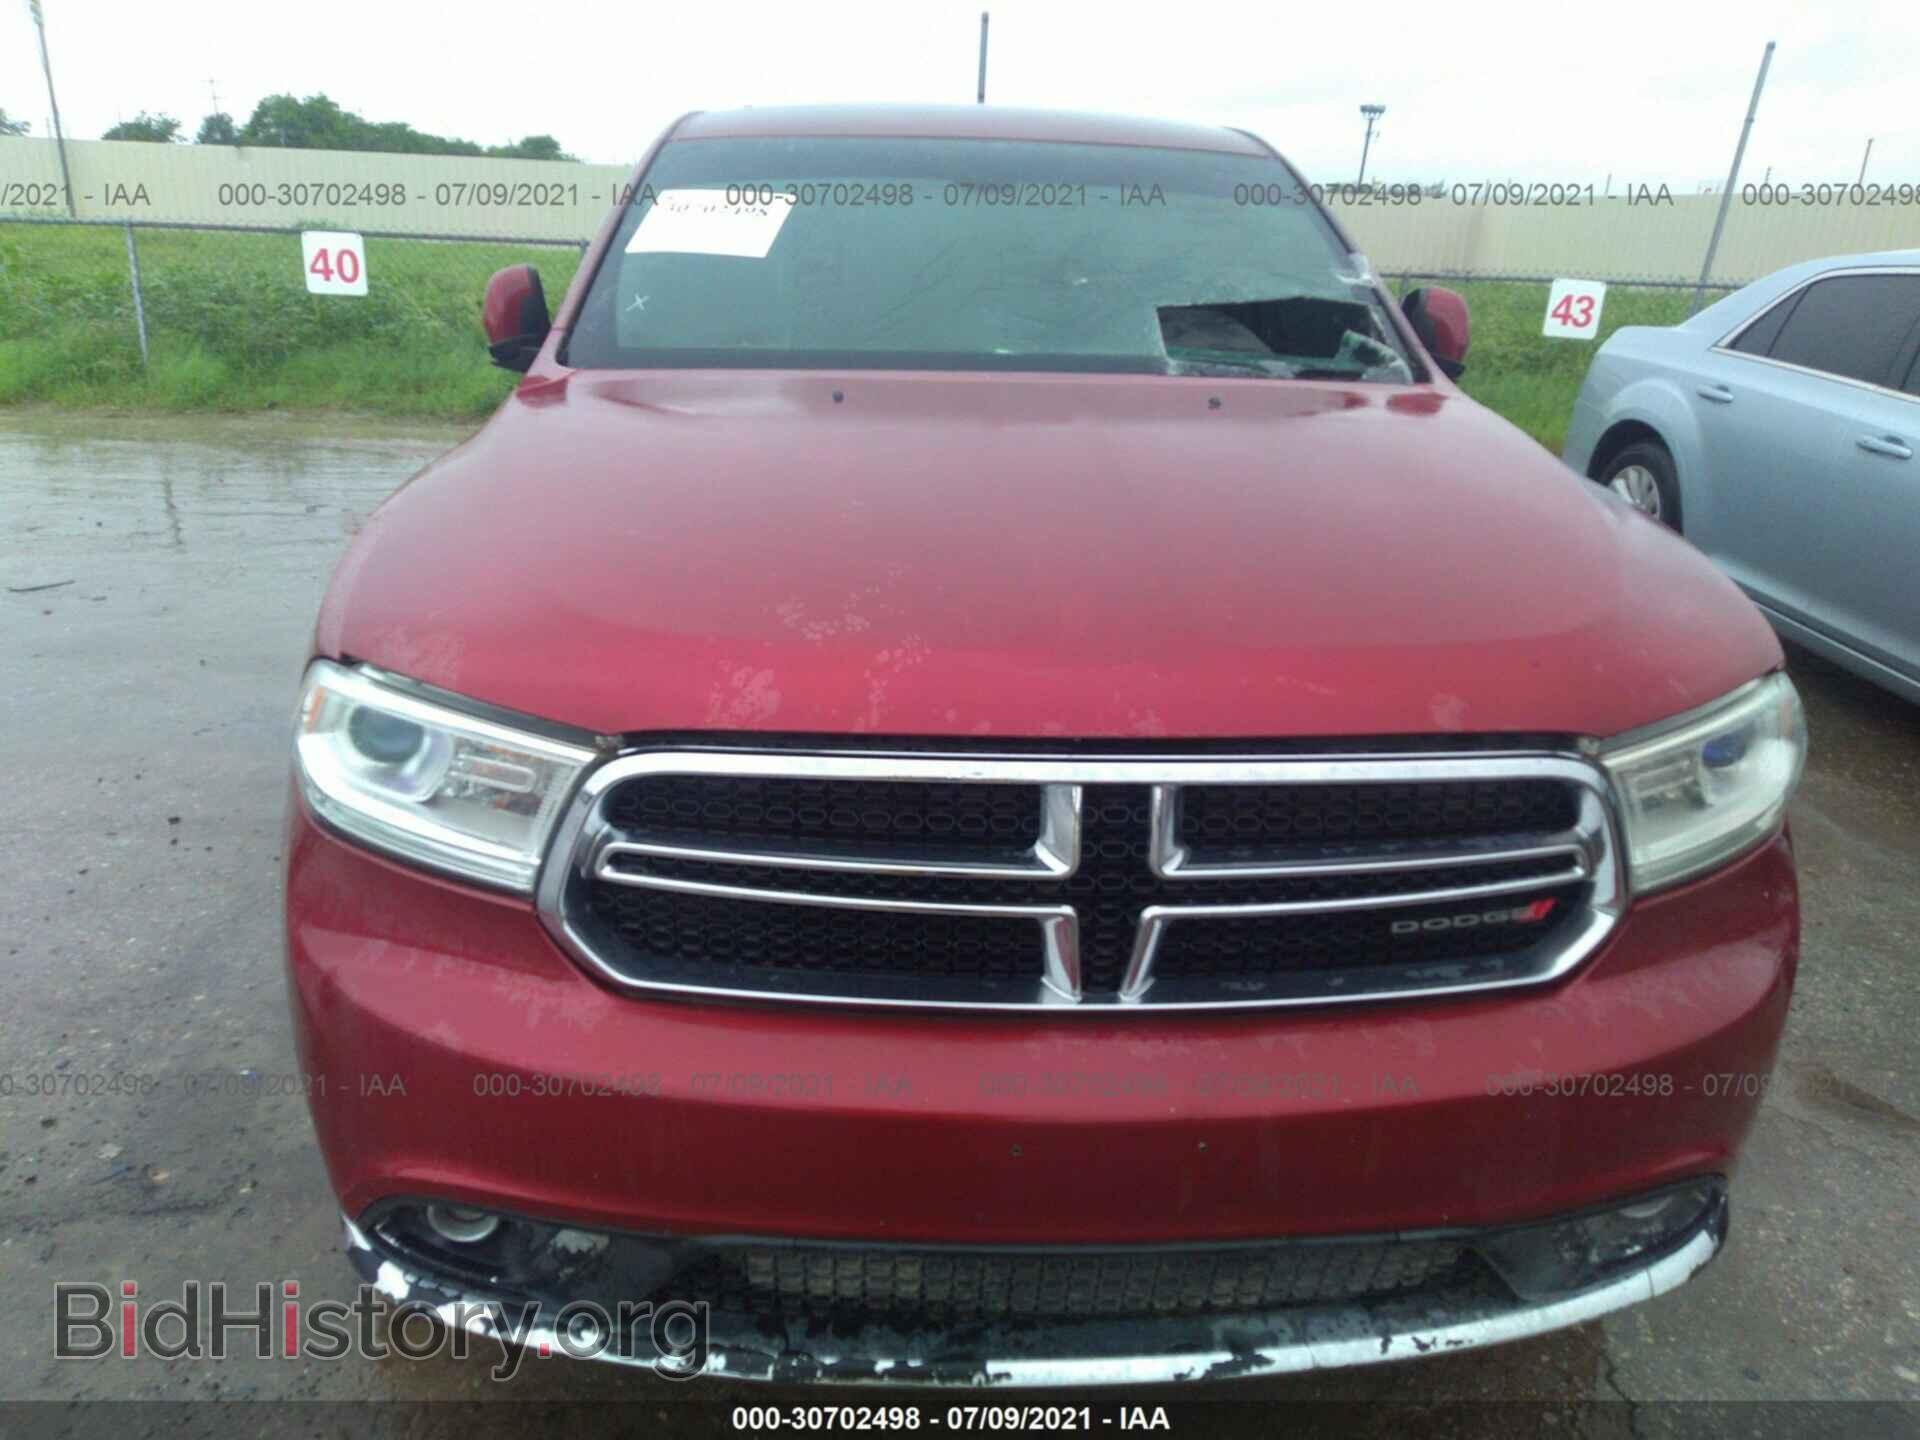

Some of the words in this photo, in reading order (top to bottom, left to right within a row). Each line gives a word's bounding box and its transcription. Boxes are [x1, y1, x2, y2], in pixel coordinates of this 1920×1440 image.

[309, 247, 361, 284] 40
[1551, 294, 1595, 328] 43
[1391, 905, 1535, 933] DODGE
